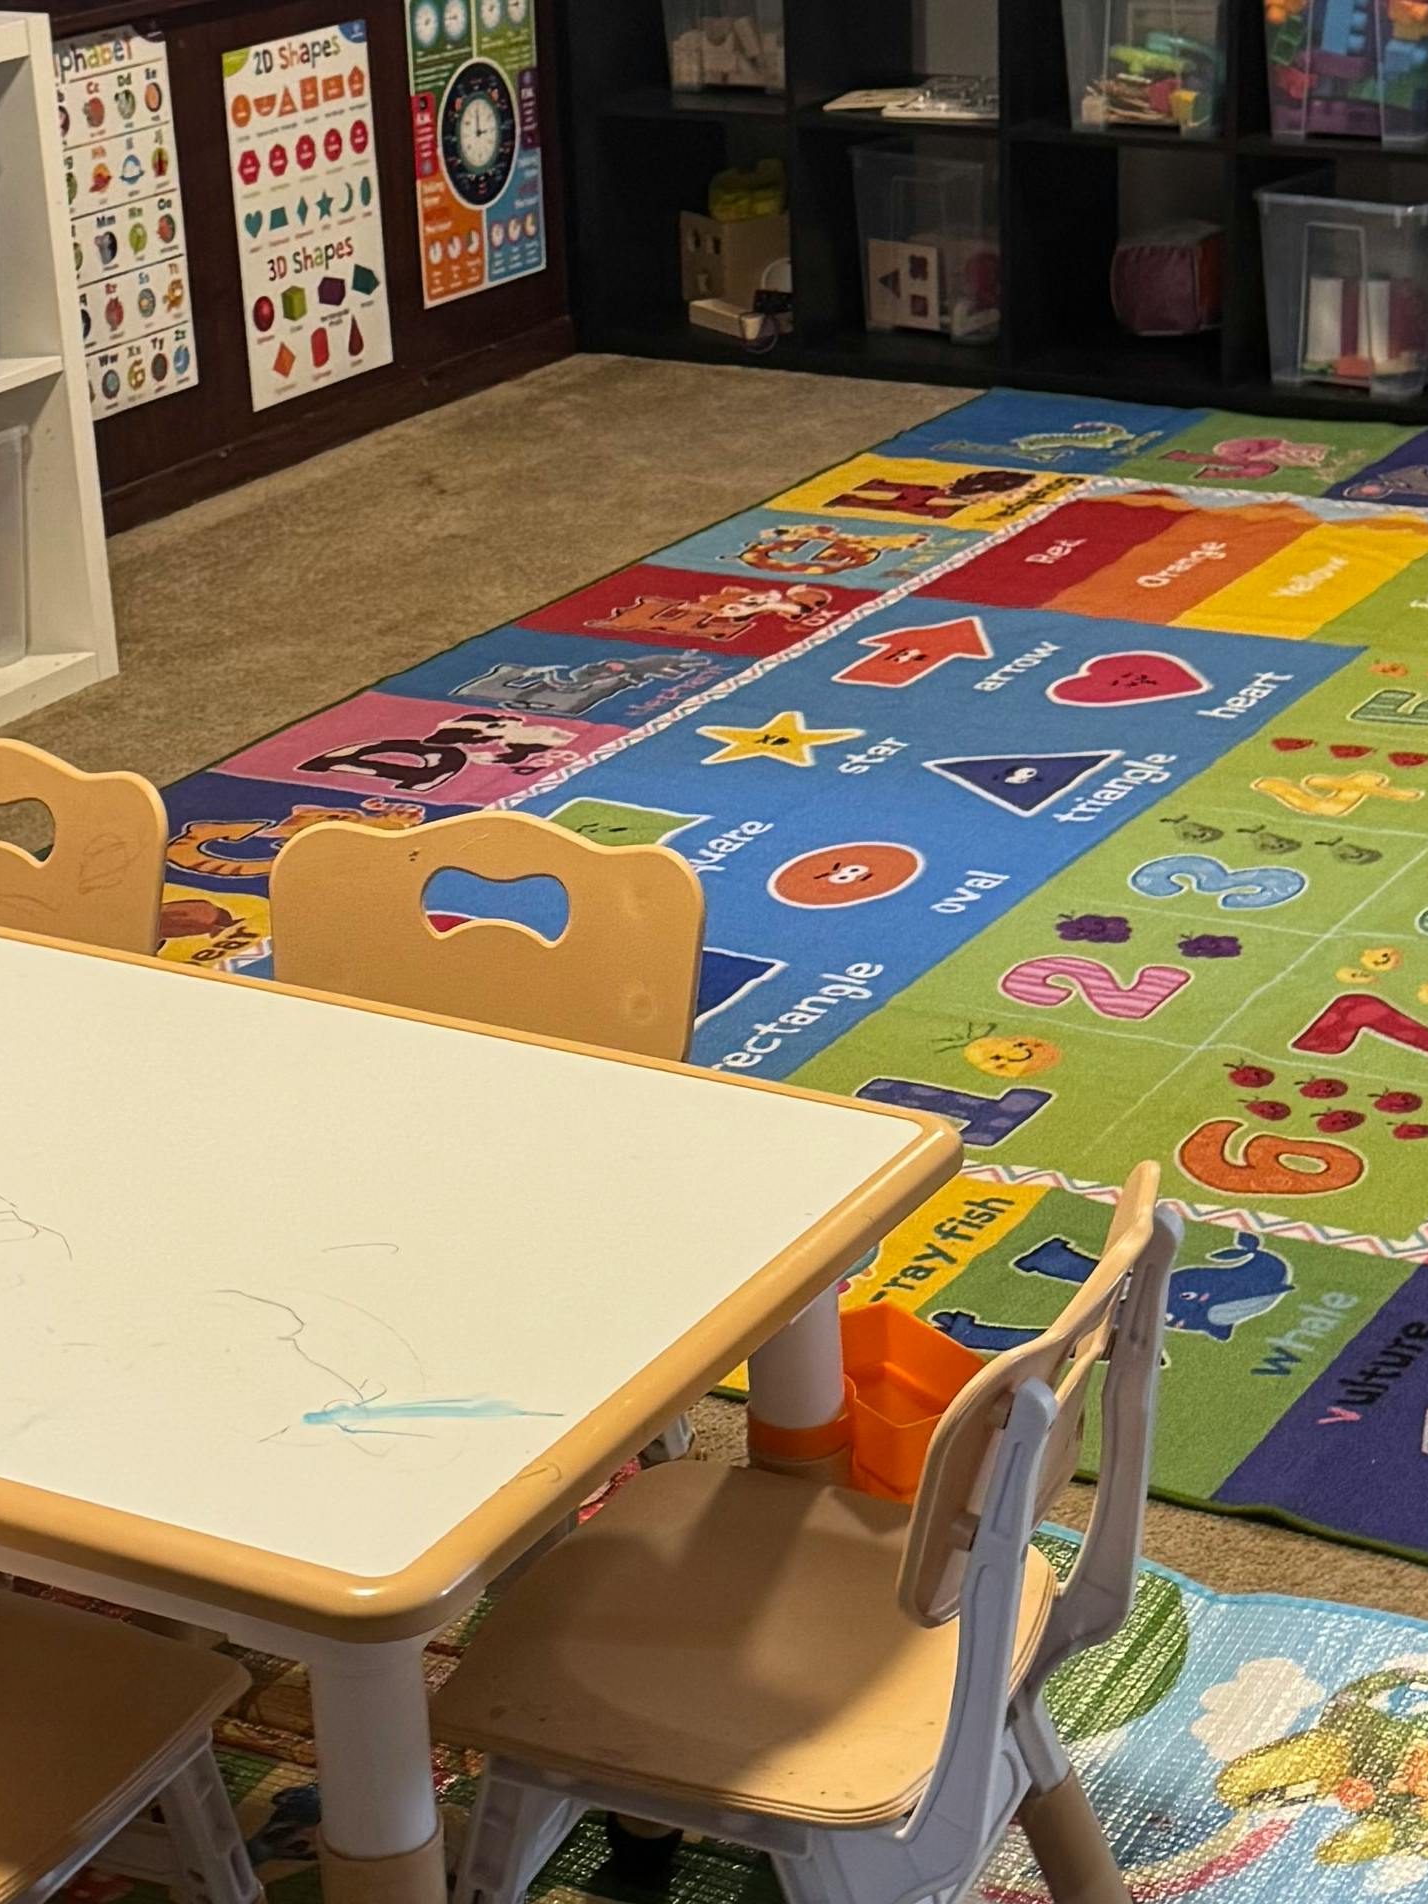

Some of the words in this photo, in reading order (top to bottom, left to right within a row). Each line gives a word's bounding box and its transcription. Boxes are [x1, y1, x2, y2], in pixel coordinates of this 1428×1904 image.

[54, 39, 132, 84] lphabet
[253, 49, 273, 75] 2D
[279, 36, 341, 69] Shapes
[267, 256, 288, 281] 3D
[292, 237, 354, 273] Shapes
[98, 354, 119, 367] Ww
[823, 479, 969, 520] H
[737, 538, 881, 576] G
[1136, 541, 1226, 591] Orange
[1276, 556, 1348, 598] Yellow
[973, 640, 1062, 691] arrow
[1197, 671, 1294, 720] heart
[296, 739, 468, 793] D
[838, 734, 909, 775] star
[1053, 751, 1177, 822] triangle
[1252, 772, 1424, 817] 4
[930, 870, 1010, 914] oval
[1130, 854, 1308, 910] 3
[191, 921, 258, 964] ear
[998, 954, 1193, 1021] 2
[1176, 1117, 1365, 1196] 6
[933, 1193, 1016, 1242] fish
[1252, 1286, 1361, 1380] whale
